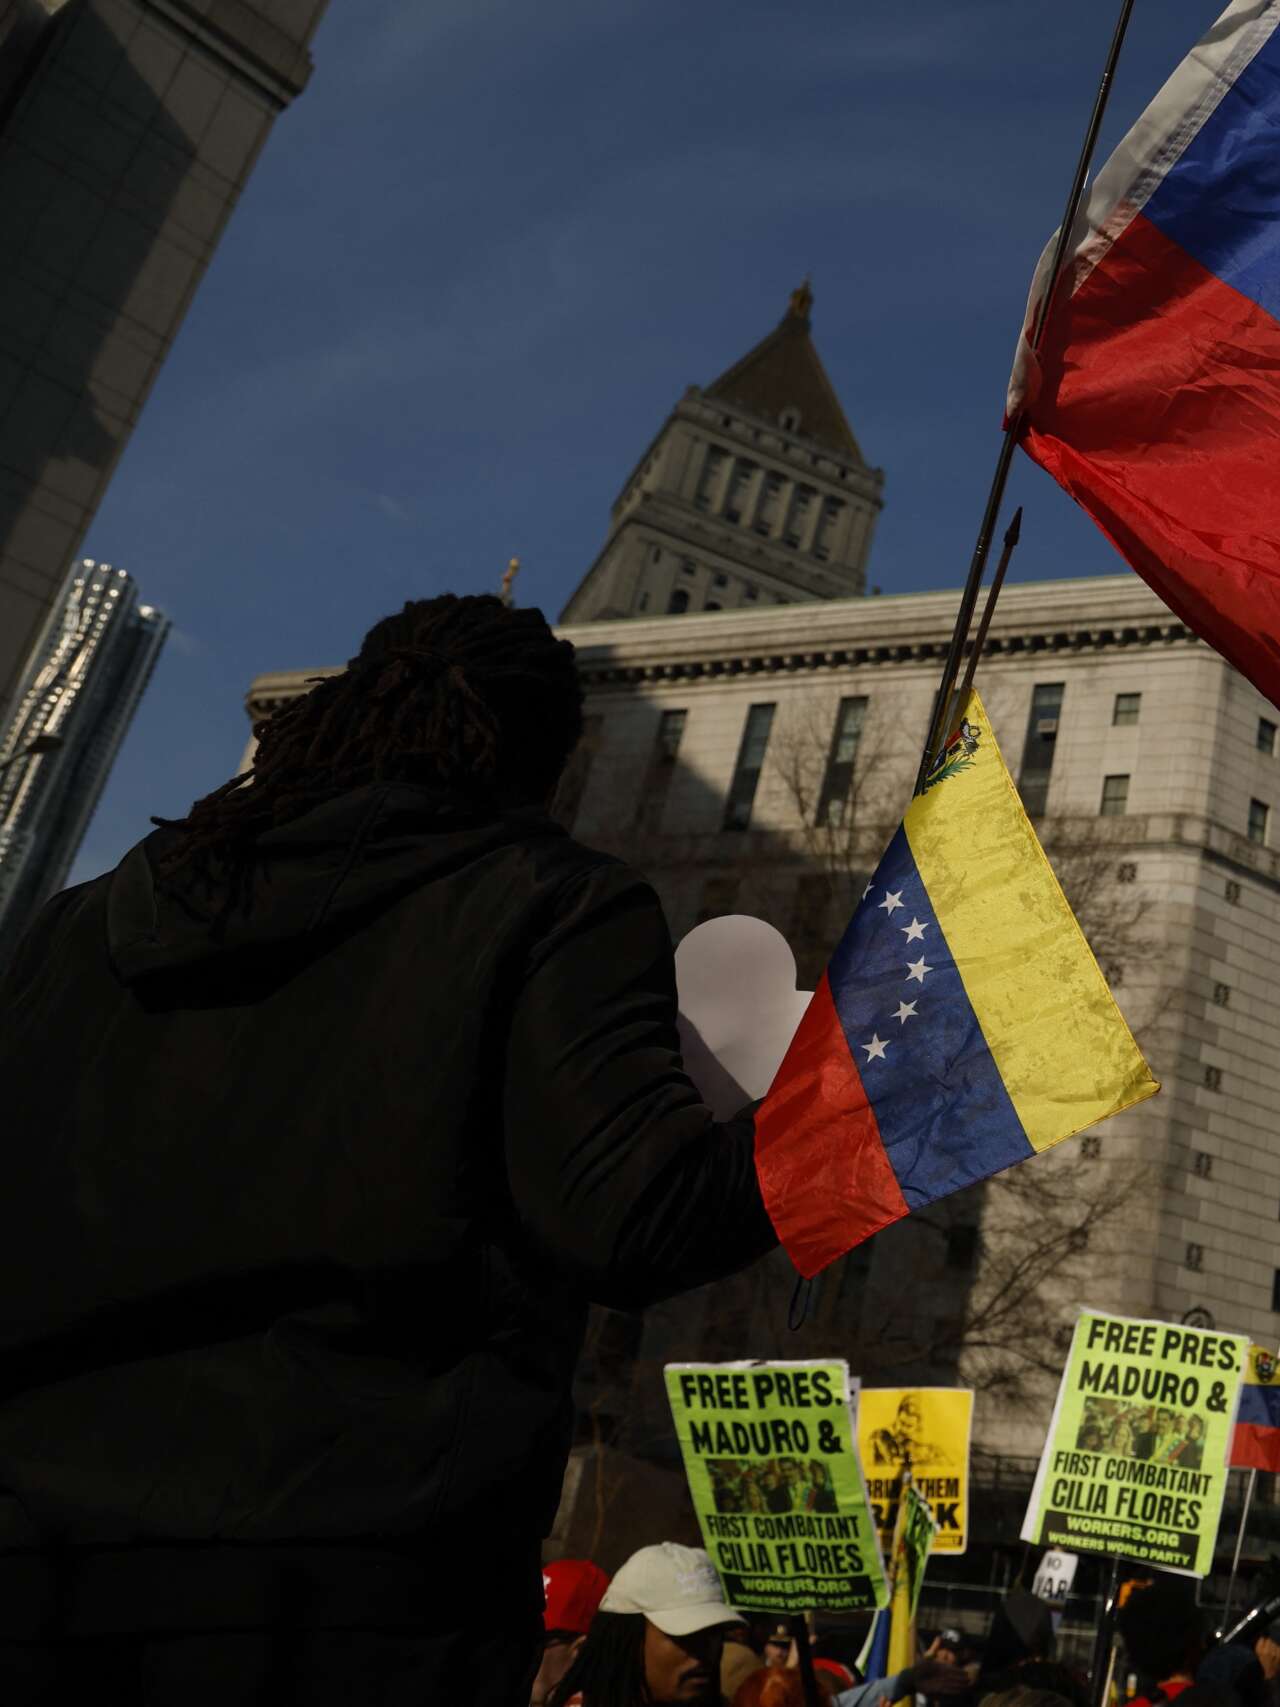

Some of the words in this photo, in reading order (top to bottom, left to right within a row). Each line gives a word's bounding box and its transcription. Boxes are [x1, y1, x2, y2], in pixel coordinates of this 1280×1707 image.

[1087, 1319, 1157, 1356] FREE
[1161, 1329, 1241, 1372] PRES.
[680, 1374, 749, 1409] FREE
[753, 1371, 842, 1409] PRES.
[1078, 1361, 1199, 1407] MADURO
[1206, 1381, 1228, 1413] &
[689, 1420, 809, 1455] MADURO
[818, 1419, 844, 1454] &
[916, 1478, 959, 1498] THEM
[1053, 1451, 1101, 1479] FIRST
[1105, 1458, 1212, 1497] COMBATANT
[1052, 1478, 1109, 1514] CILIA
[1115, 1487, 1203, 1530] FLORES
[705, 1514, 750, 1538] FIRST
[753, 1515, 860, 1540] COMBATANT
[1067, 1516, 1182, 1549] WORKERS.ORG
[717, 1541, 774, 1573] CILIA
[775, 1542, 864, 1574] FLORES
[1048, 1532, 1106, 1552] WORKERS
[1107, 1540, 1149, 1559] WORLD
[1149, 1550, 1192, 1567] PARTY
[739, 1577, 853, 1593] WORKERS.ORG
